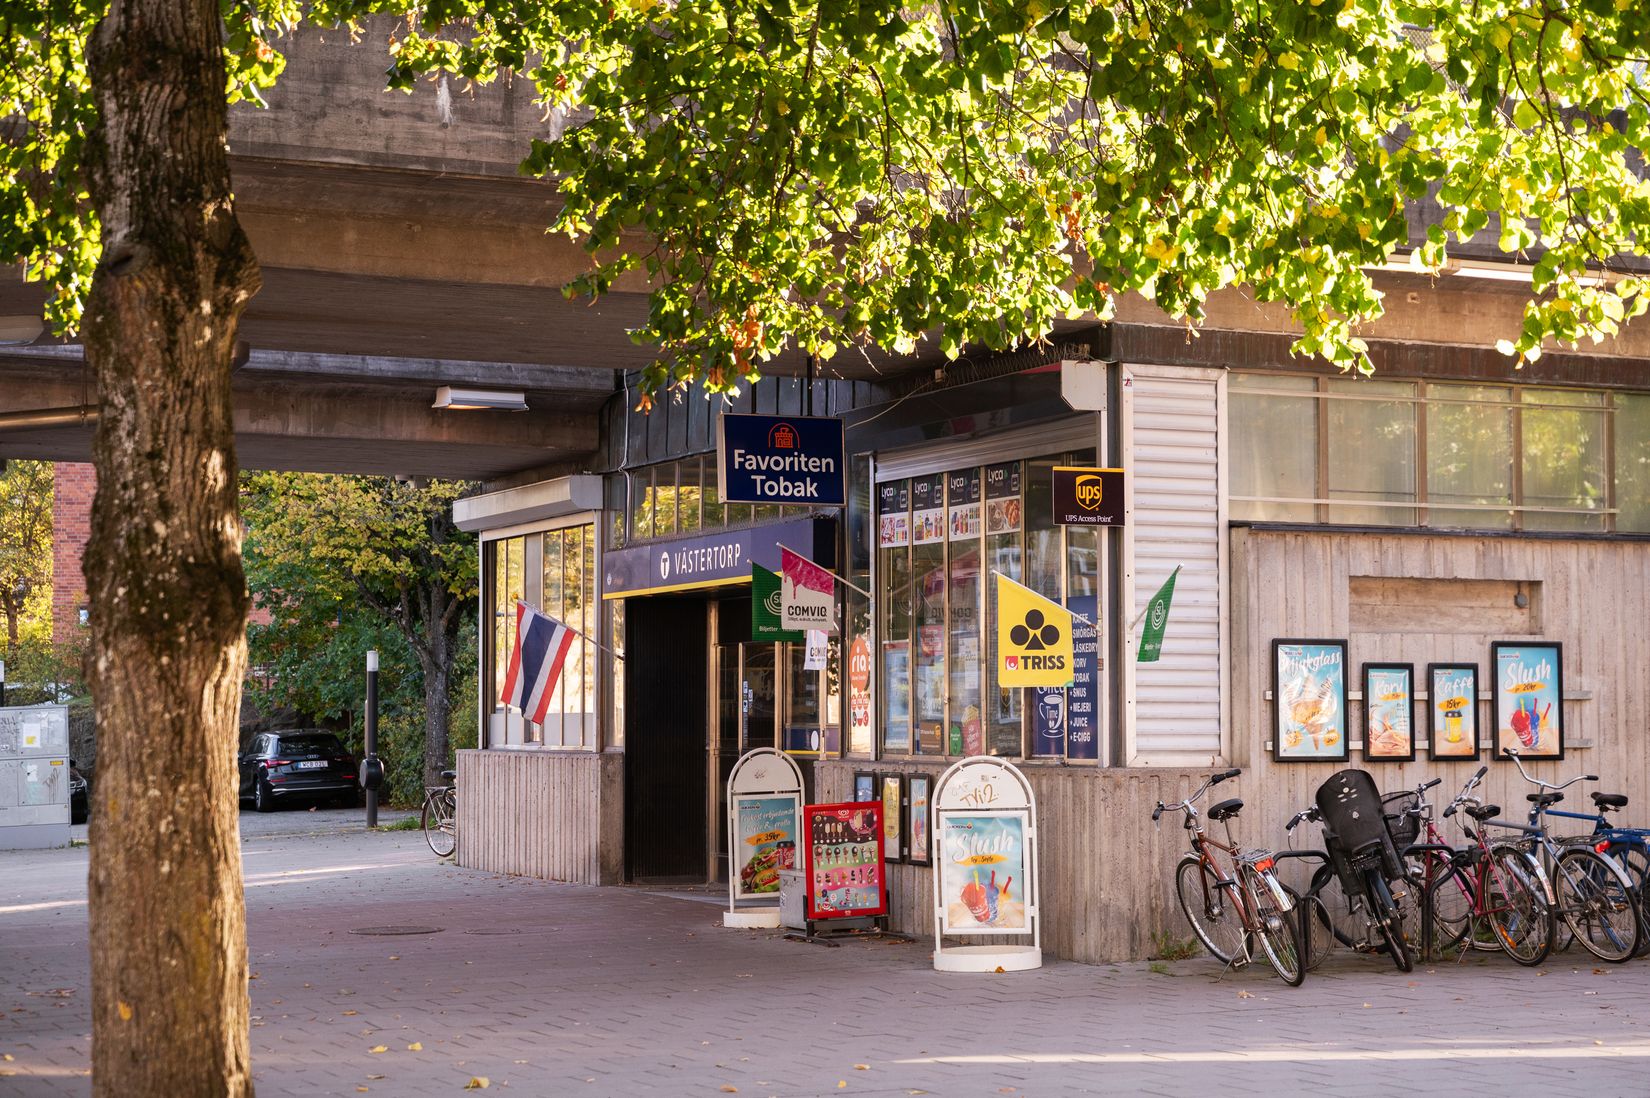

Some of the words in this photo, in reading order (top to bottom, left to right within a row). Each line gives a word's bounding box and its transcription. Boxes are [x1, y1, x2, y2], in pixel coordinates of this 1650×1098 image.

[734, 449, 834, 473] Favoriten
[950, 477, 964, 490] Lyca
[988, 469, 1003, 484] Lyca
[751, 475, 818, 497] Tobak
[881, 486, 894, 499] Lyca
[914, 482, 928, 495] Lyca
[1078, 485, 1100, 504] ups
[674, 543, 741, 575] VÄSTERTORP
[787, 605, 828, 617] COMVIQ
[851, 646, 867, 673] ria
[1020, 655, 1065, 670] TRISS
[1073, 672, 1090, 682] TOBAK
[1504, 657, 1551, 690] Slush
[1073, 687, 1087, 698] SNUS
[1434, 676, 1474, 697] Kaffe
[1045, 705, 1058, 719] Time
[1073, 702, 1091, 712] MEJERI
[1073, 717, 1088, 727] JUICE
[952, 828, 1014, 861] Slush
